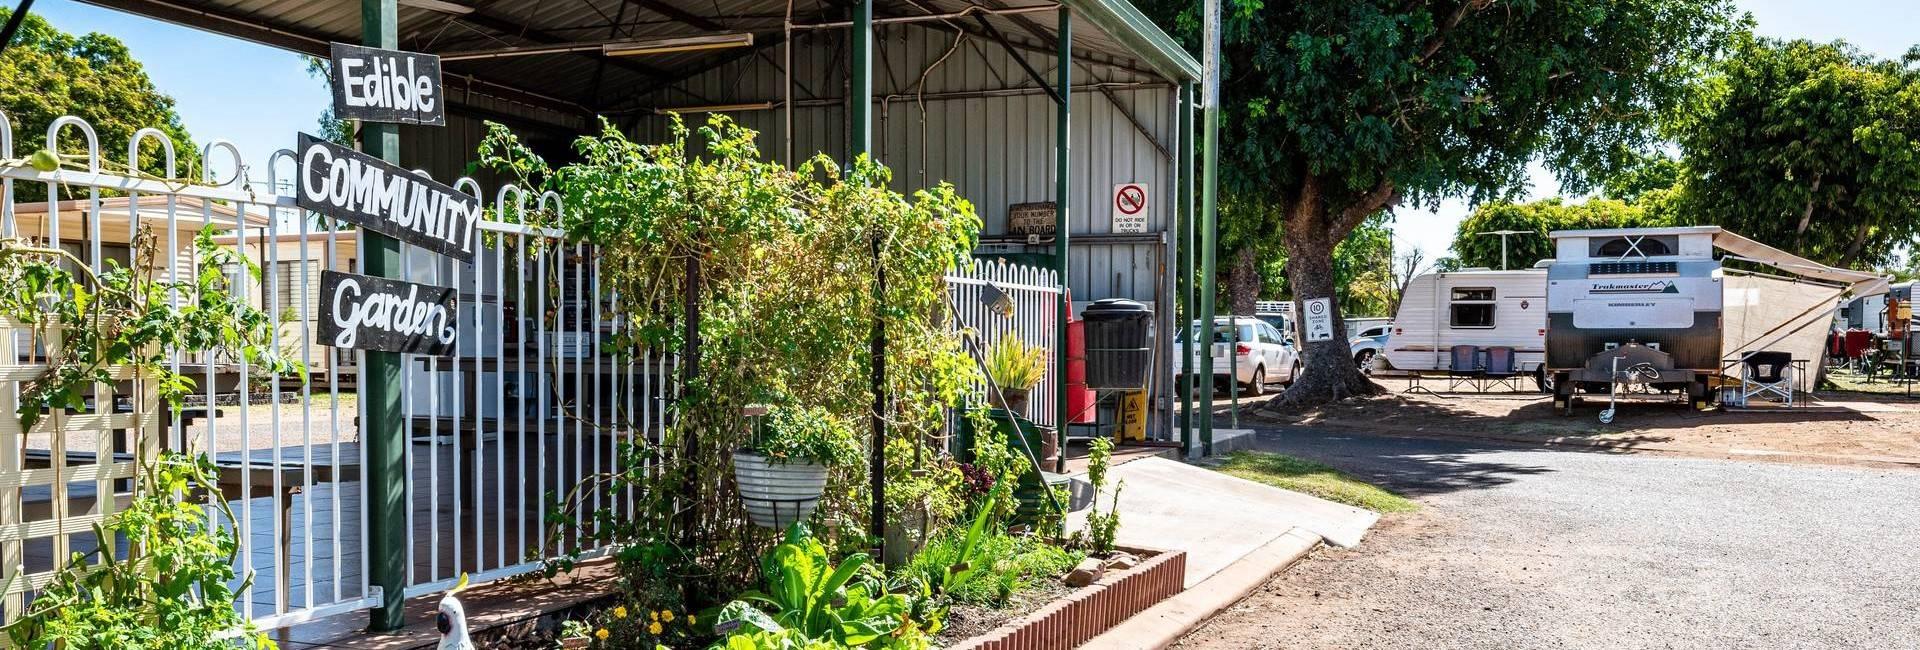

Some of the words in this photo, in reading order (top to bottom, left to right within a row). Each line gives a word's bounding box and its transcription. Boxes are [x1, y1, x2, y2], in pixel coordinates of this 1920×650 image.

[341, 56, 434, 113] Edible
[302, 144, 479, 253] COMMUNITY
[1030, 210, 1055, 218] NUMBER
[1029, 225, 1057, 235] BOARD
[332, 278, 456, 348] Garden
[1313, 304, 1321, 312] 10
